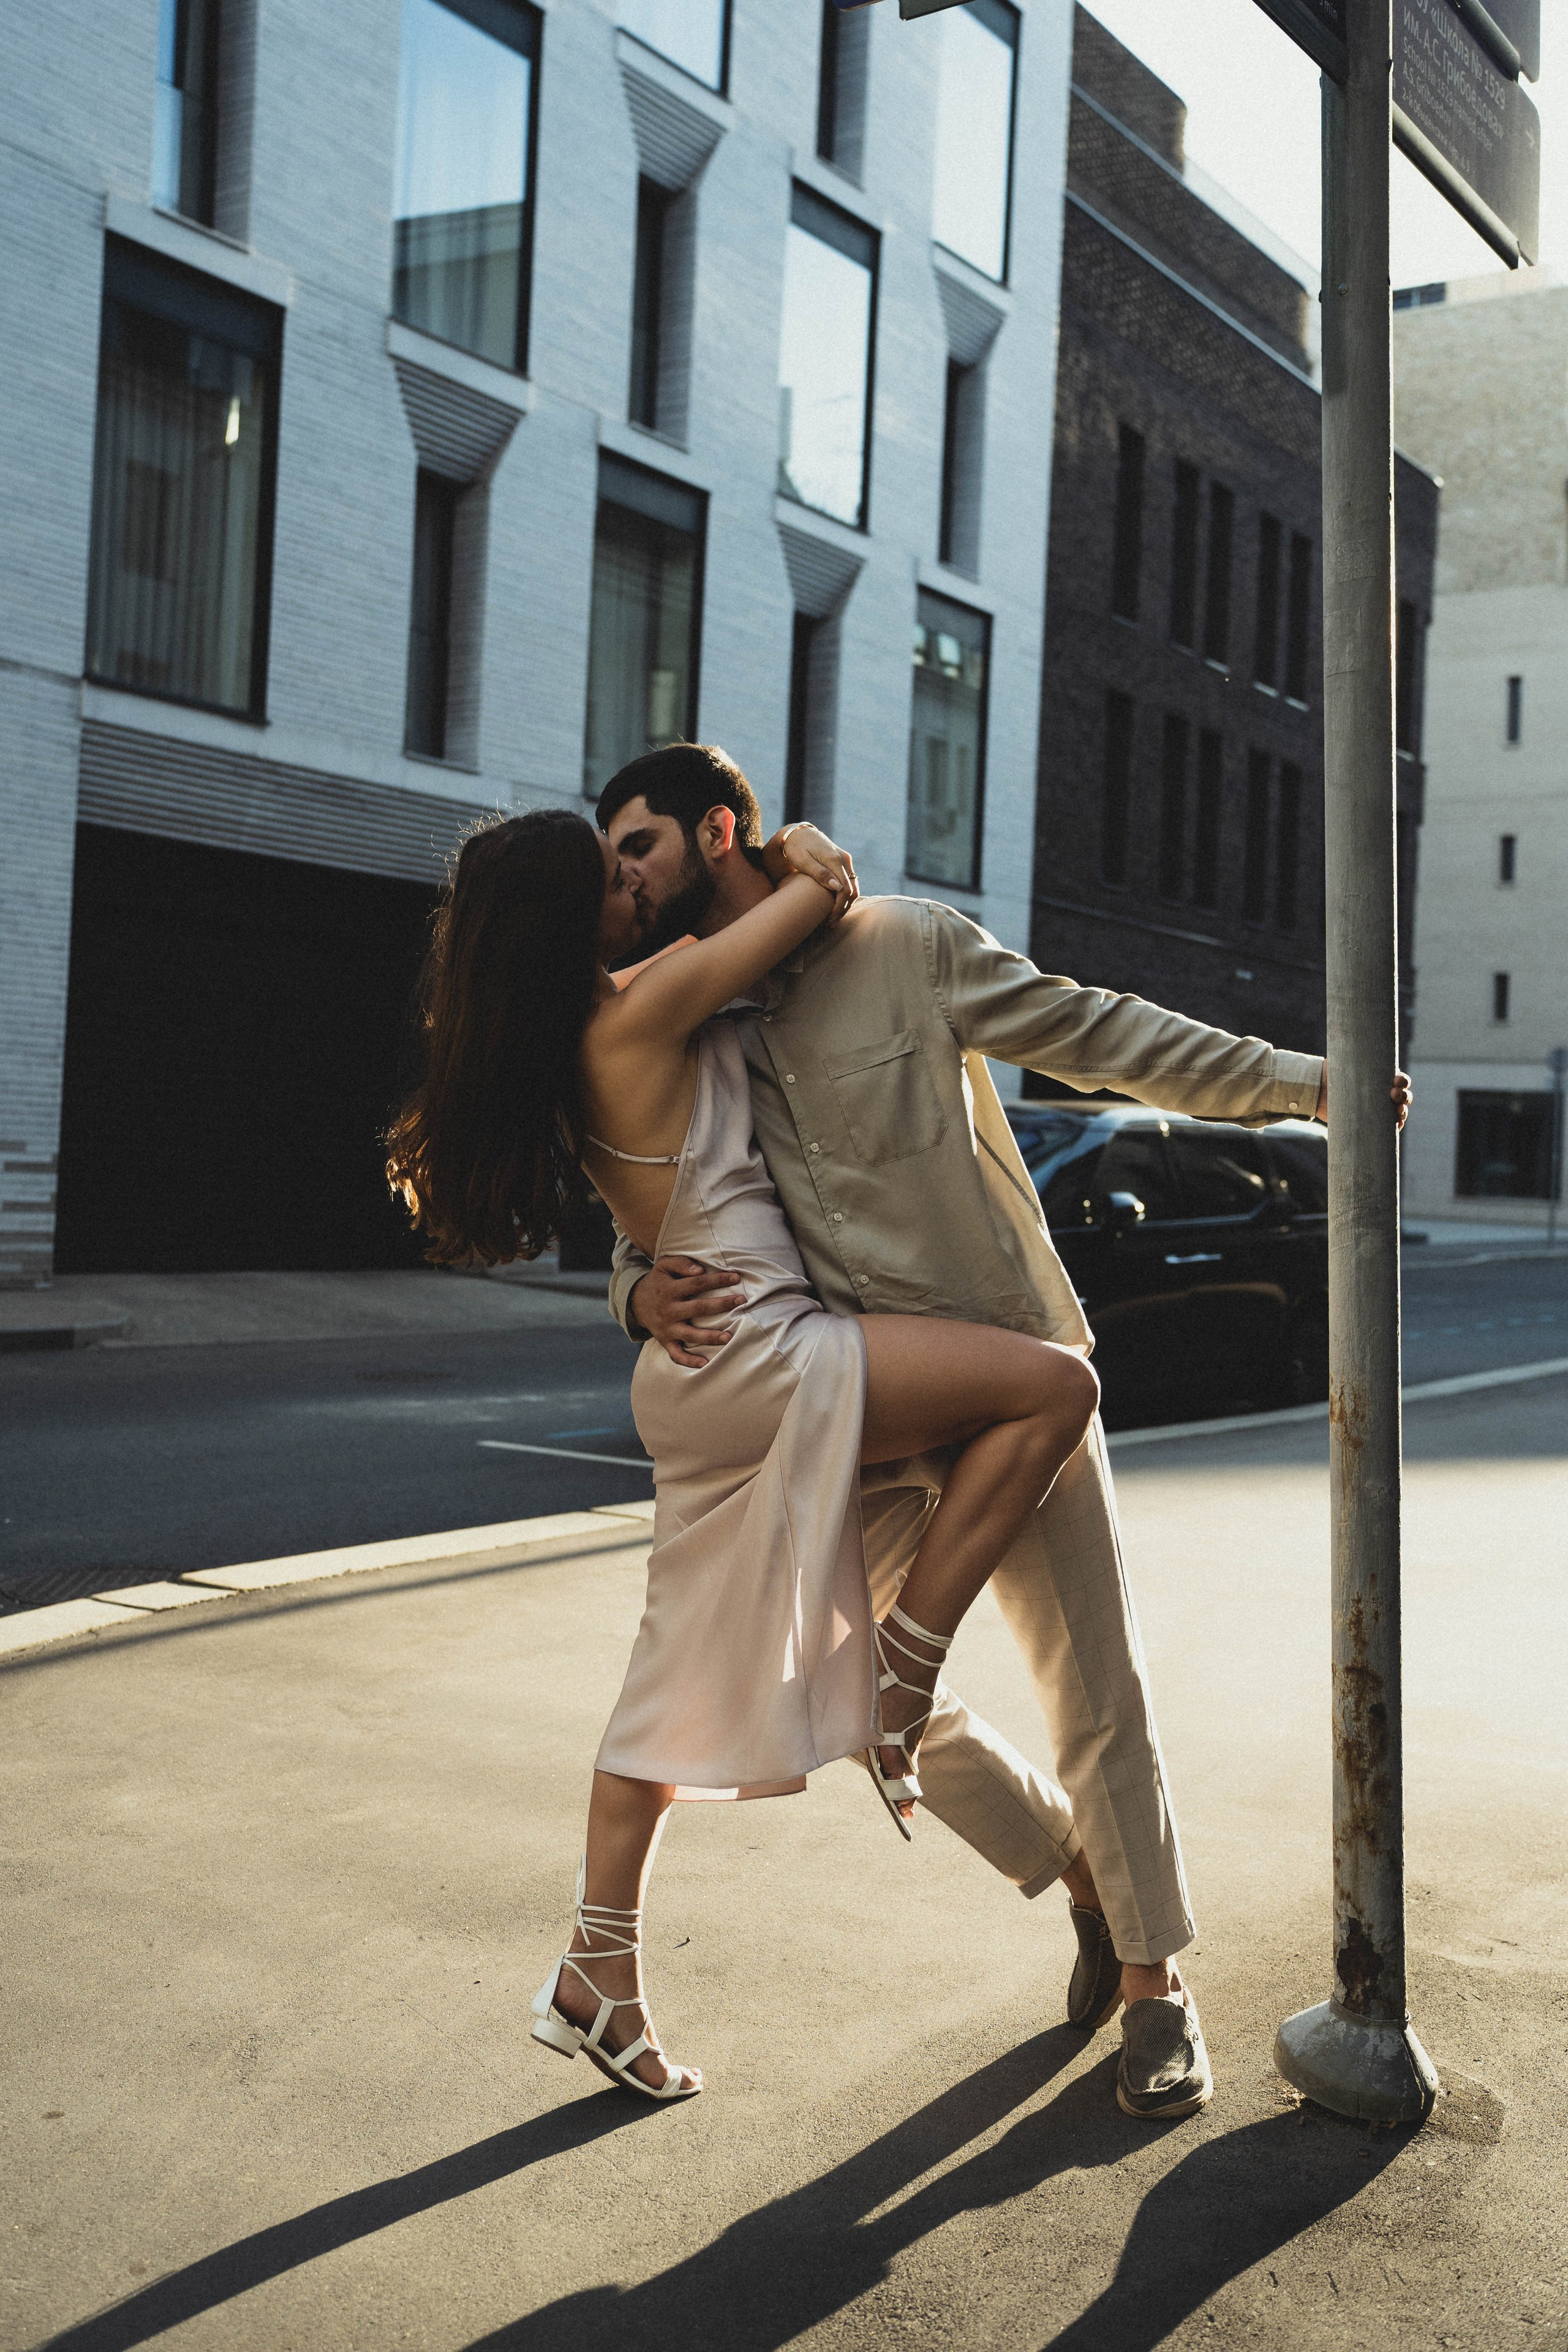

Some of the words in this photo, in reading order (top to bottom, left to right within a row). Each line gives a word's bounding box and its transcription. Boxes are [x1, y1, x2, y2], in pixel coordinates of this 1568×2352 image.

[1403, 36, 1427, 77] School
[1437, 78, 1452, 107] 1529
[1416, 76, 1451, 127] Griboedov
[1471, 50, 1482, 82] №
[1484, 69, 1505, 110] 1529
